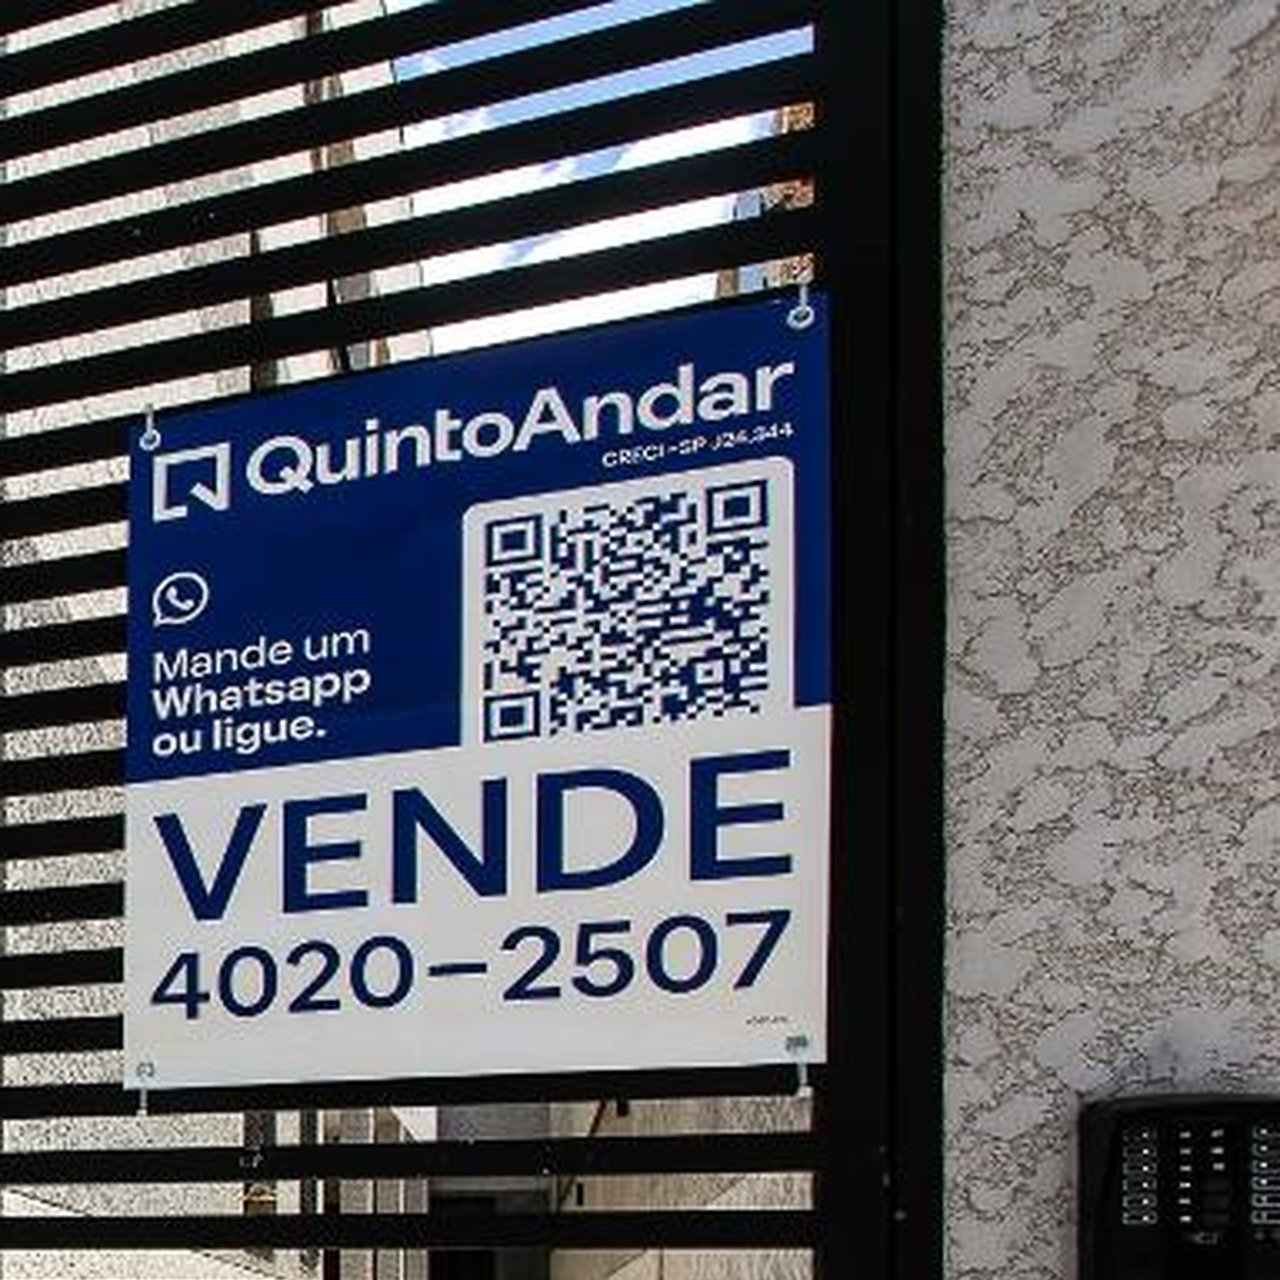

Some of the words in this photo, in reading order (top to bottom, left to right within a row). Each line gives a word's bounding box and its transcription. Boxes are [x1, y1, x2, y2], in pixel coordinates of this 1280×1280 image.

[246, 360, 794, 495] QuintoAndar
[601, 435, 706, 468] CRECI-SP
[153, 635, 294, 683] Mande
[303, 628, 371, 661] um
[152, 668, 372, 720] Whatsapp
[152, 729, 202, 756] ou
[213, 716, 327, 754] ligue.
[153, 749, 793, 921] VENDE
